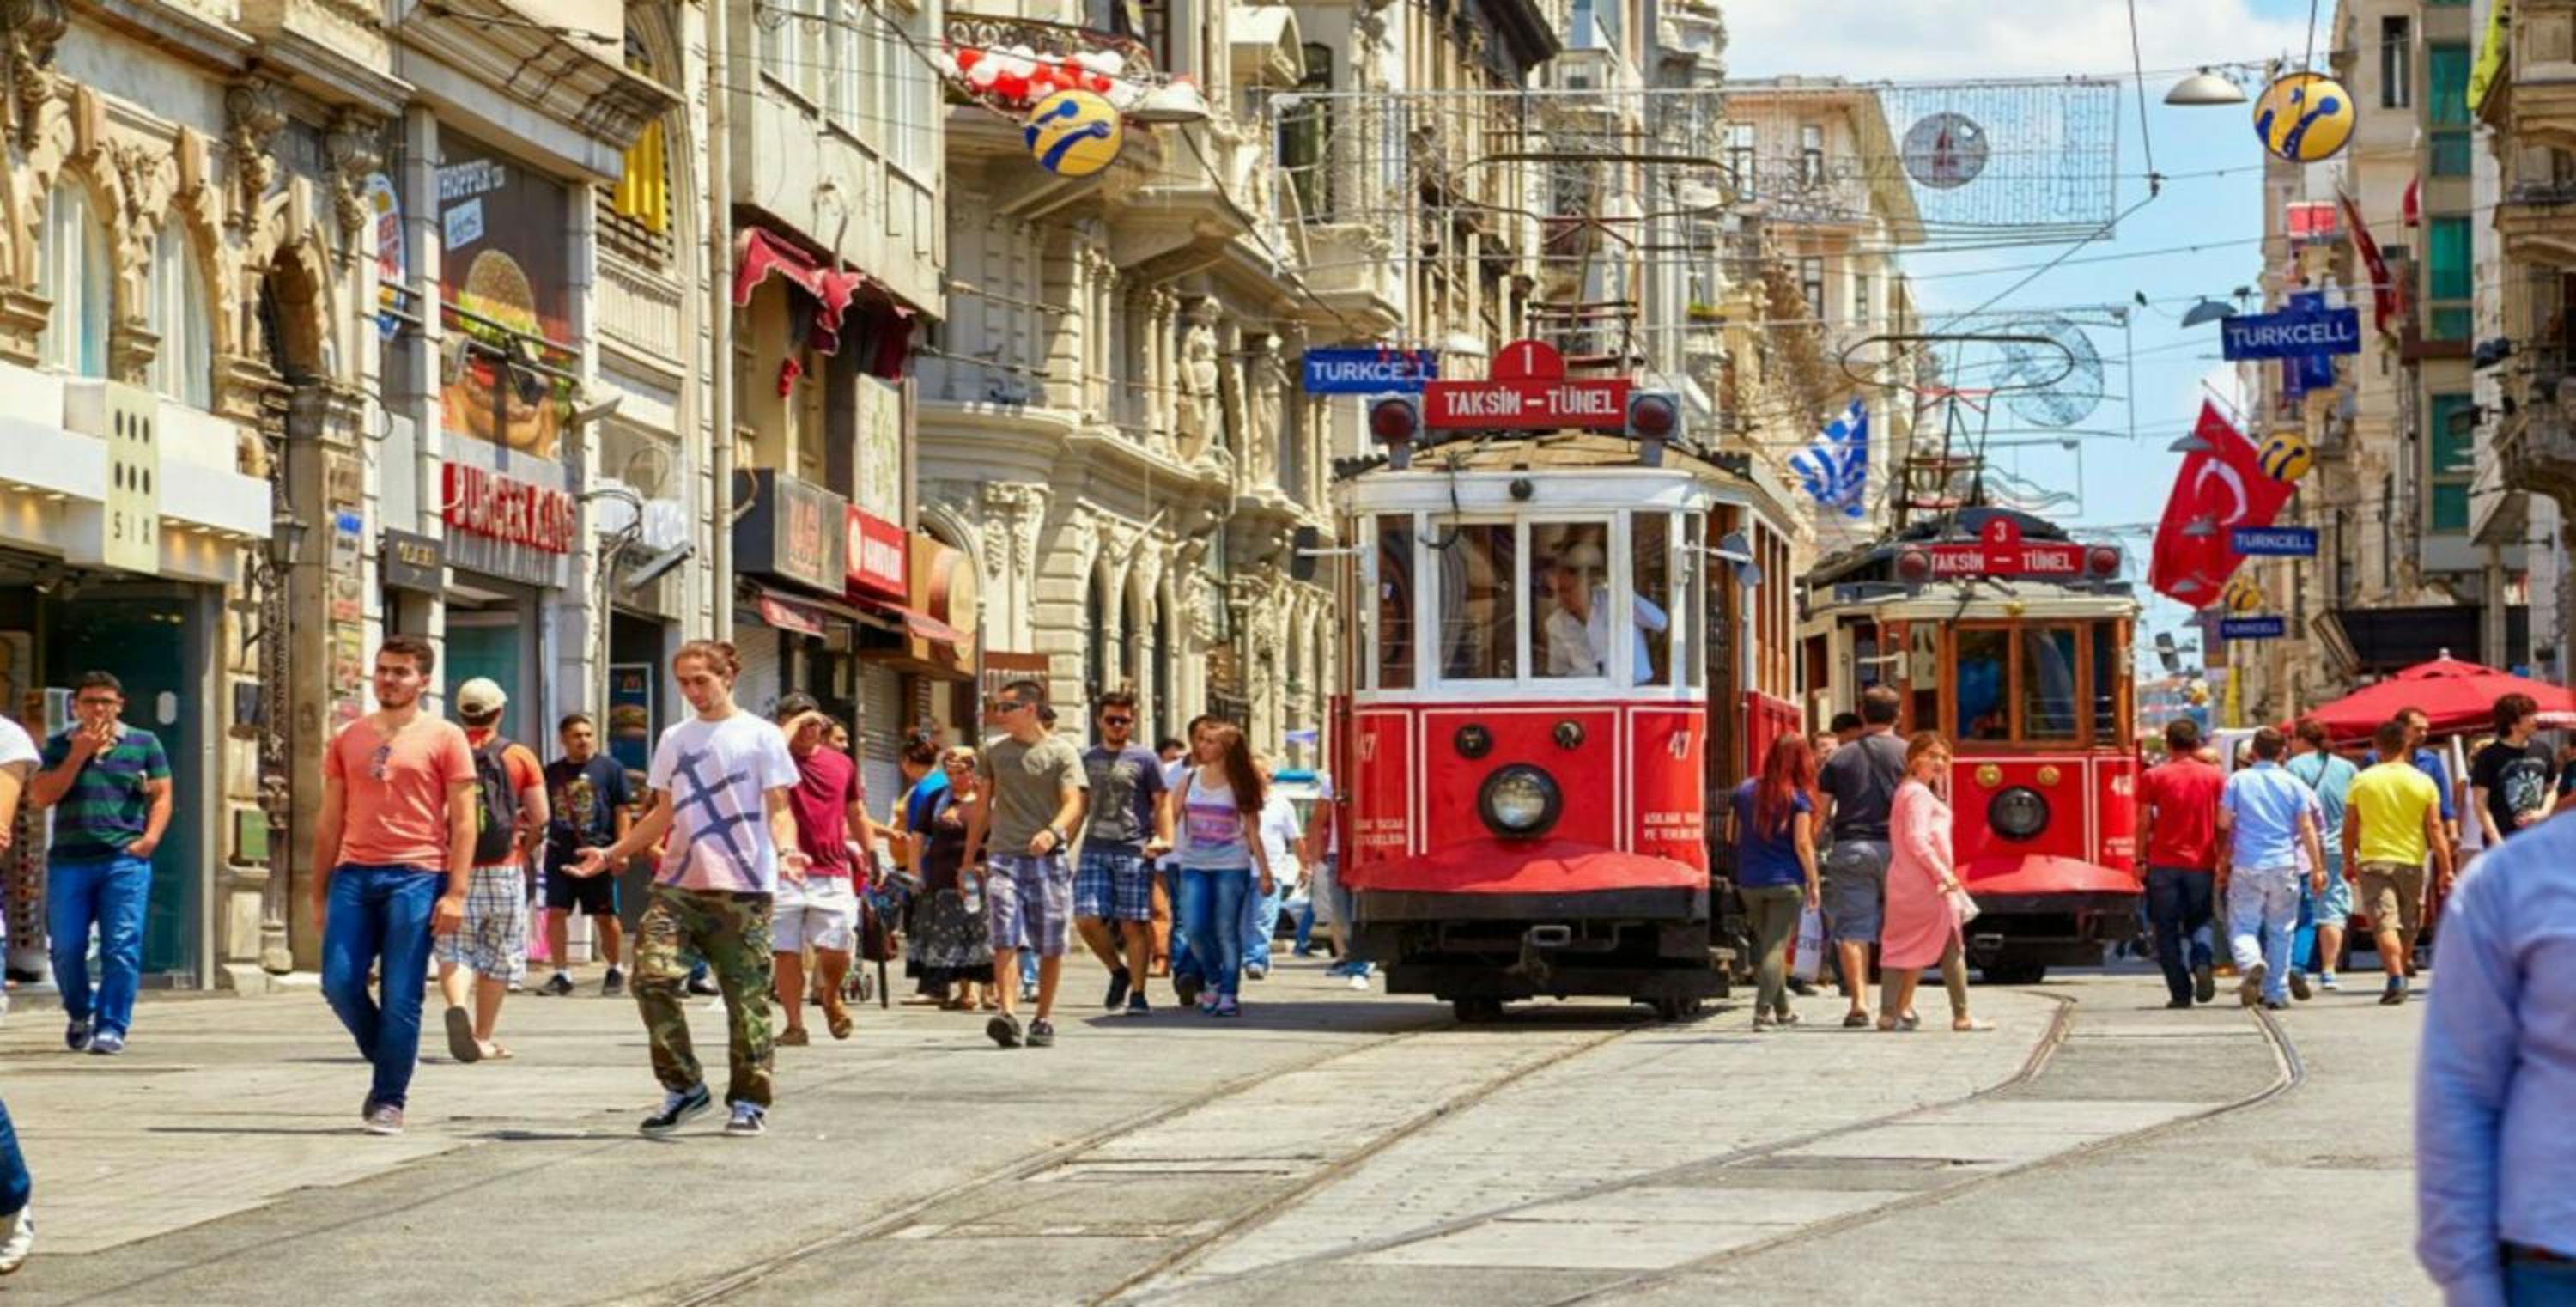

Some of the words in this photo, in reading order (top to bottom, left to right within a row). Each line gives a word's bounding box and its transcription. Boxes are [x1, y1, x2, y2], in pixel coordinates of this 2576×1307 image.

[2229, 322, 2354, 348] TURKCELL
[1523, 345, 1533, 375] 1
[1546, 384, 1619, 415] TÜNEL
[442, 461, 526, 543] BURGER
[114, 510, 150, 545] SIX
[1993, 520, 2008, 542] 3
[2234, 532, 2312, 550] TURKCELL
[2021, 550, 2075, 571] TÜNEL
[1667, 730, 1692, 761] 47
